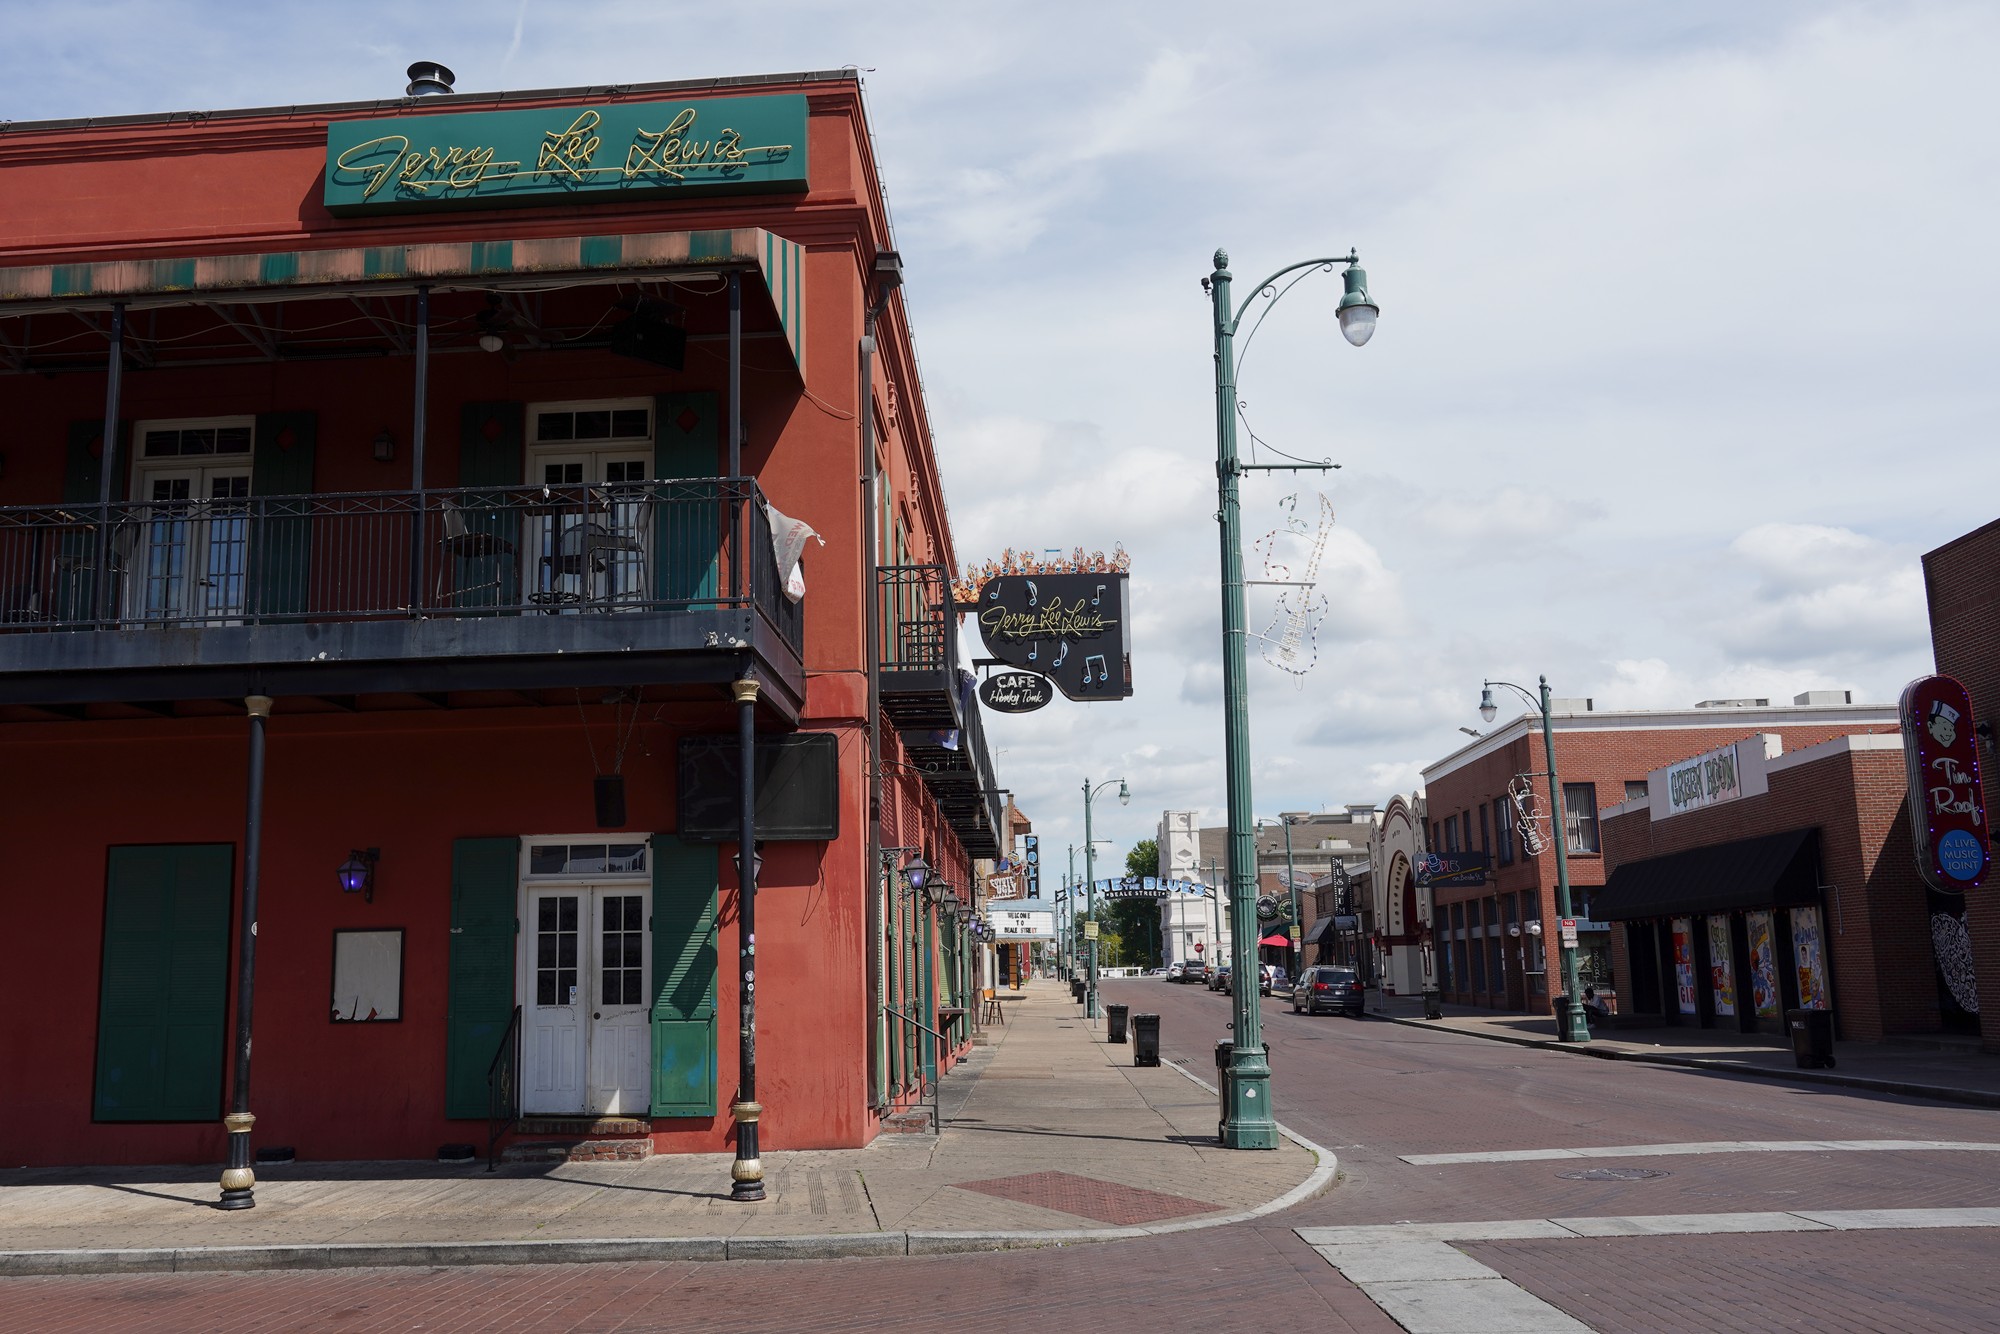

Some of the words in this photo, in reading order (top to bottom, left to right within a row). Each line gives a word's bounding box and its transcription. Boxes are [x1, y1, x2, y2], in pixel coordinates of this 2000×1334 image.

[338, 135, 520, 198] Jerry
[539, 111, 601, 181] Lee
[624, 108, 792, 179] Lewis
[981, 605, 1037, 637] Jerry
[1040, 597, 1062, 635] Lee
[1060, 599, 1118, 636] Lewis
[996, 675, 1036, 688] CAFE
[989, 688, 1020, 706] Honky
[1021, 688, 1043, 703] Tonk
[1671, 762, 1705, 807] GREEN
[1704, 753, 1735, 799] ROOM
[1932, 757, 1972, 785] Tin
[1929, 786, 1981, 827] Roof
[1955, 839, 1976, 848] LIVE
[1944, 850, 1979, 859] MUSIC
[1946, 861, 1978, 870] JOINT
[1143, 876, 1205, 896] BLUES
